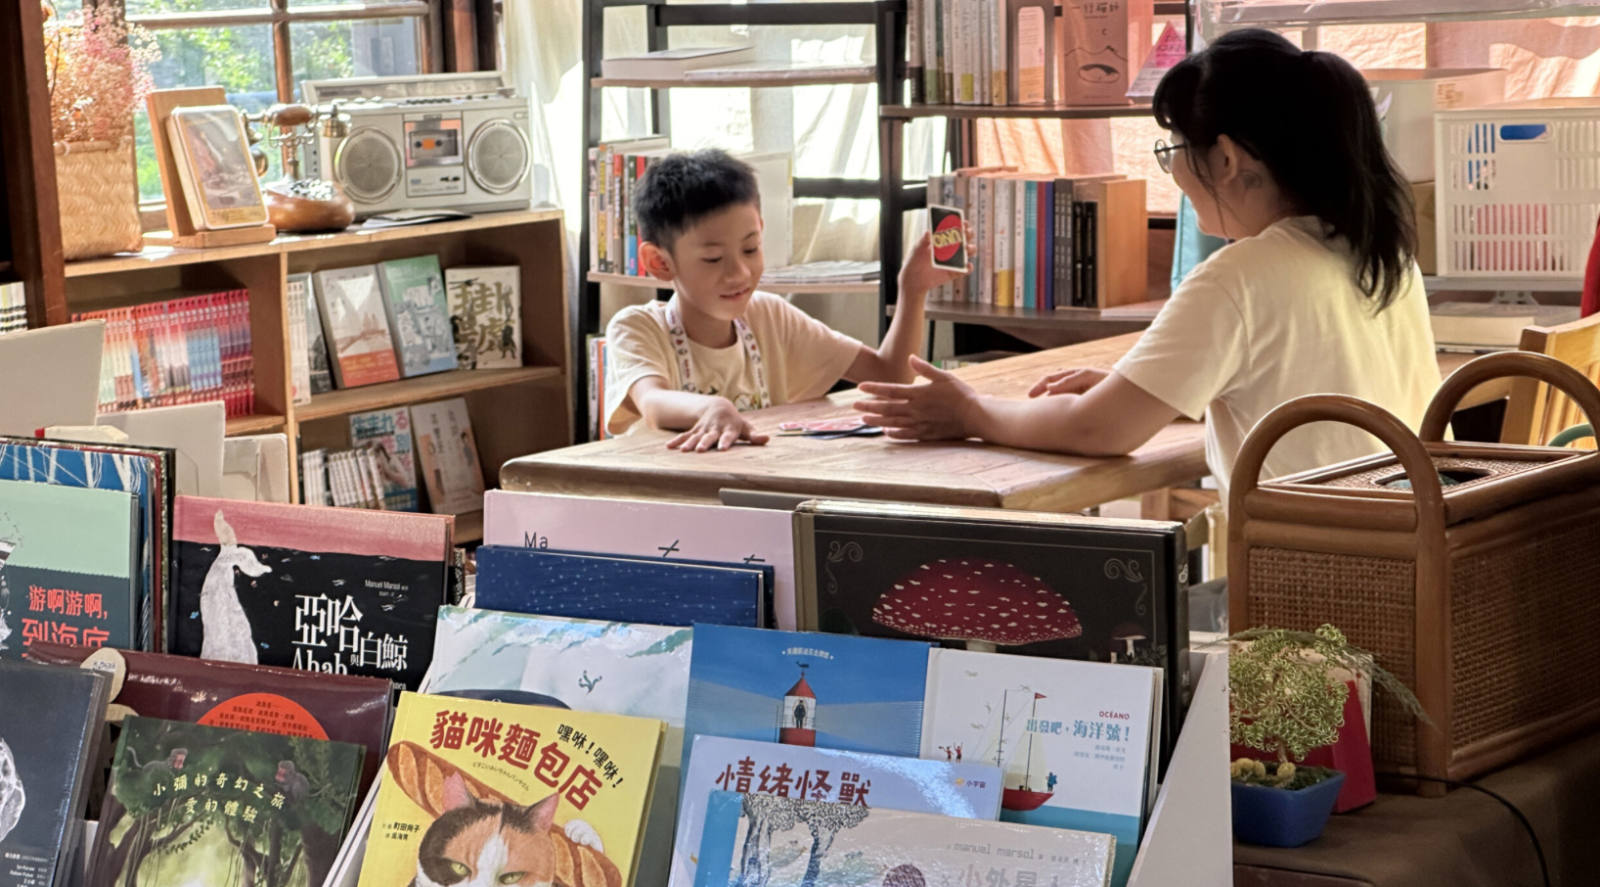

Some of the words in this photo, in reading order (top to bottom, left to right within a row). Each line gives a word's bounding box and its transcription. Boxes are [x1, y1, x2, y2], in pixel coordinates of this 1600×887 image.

[933, 228, 962, 249] UNO
[1098, 711, 1130, 720] OCÉANO
[429, 710, 603, 811] 貓咪麵包店
[153, 772, 286, 810] 小彌的奇幻之旅
[185, 797, 258, 823] 愛的體驗
[954, 843, 991, 854] manuel
[997, 846, 1034, 859] marsol
